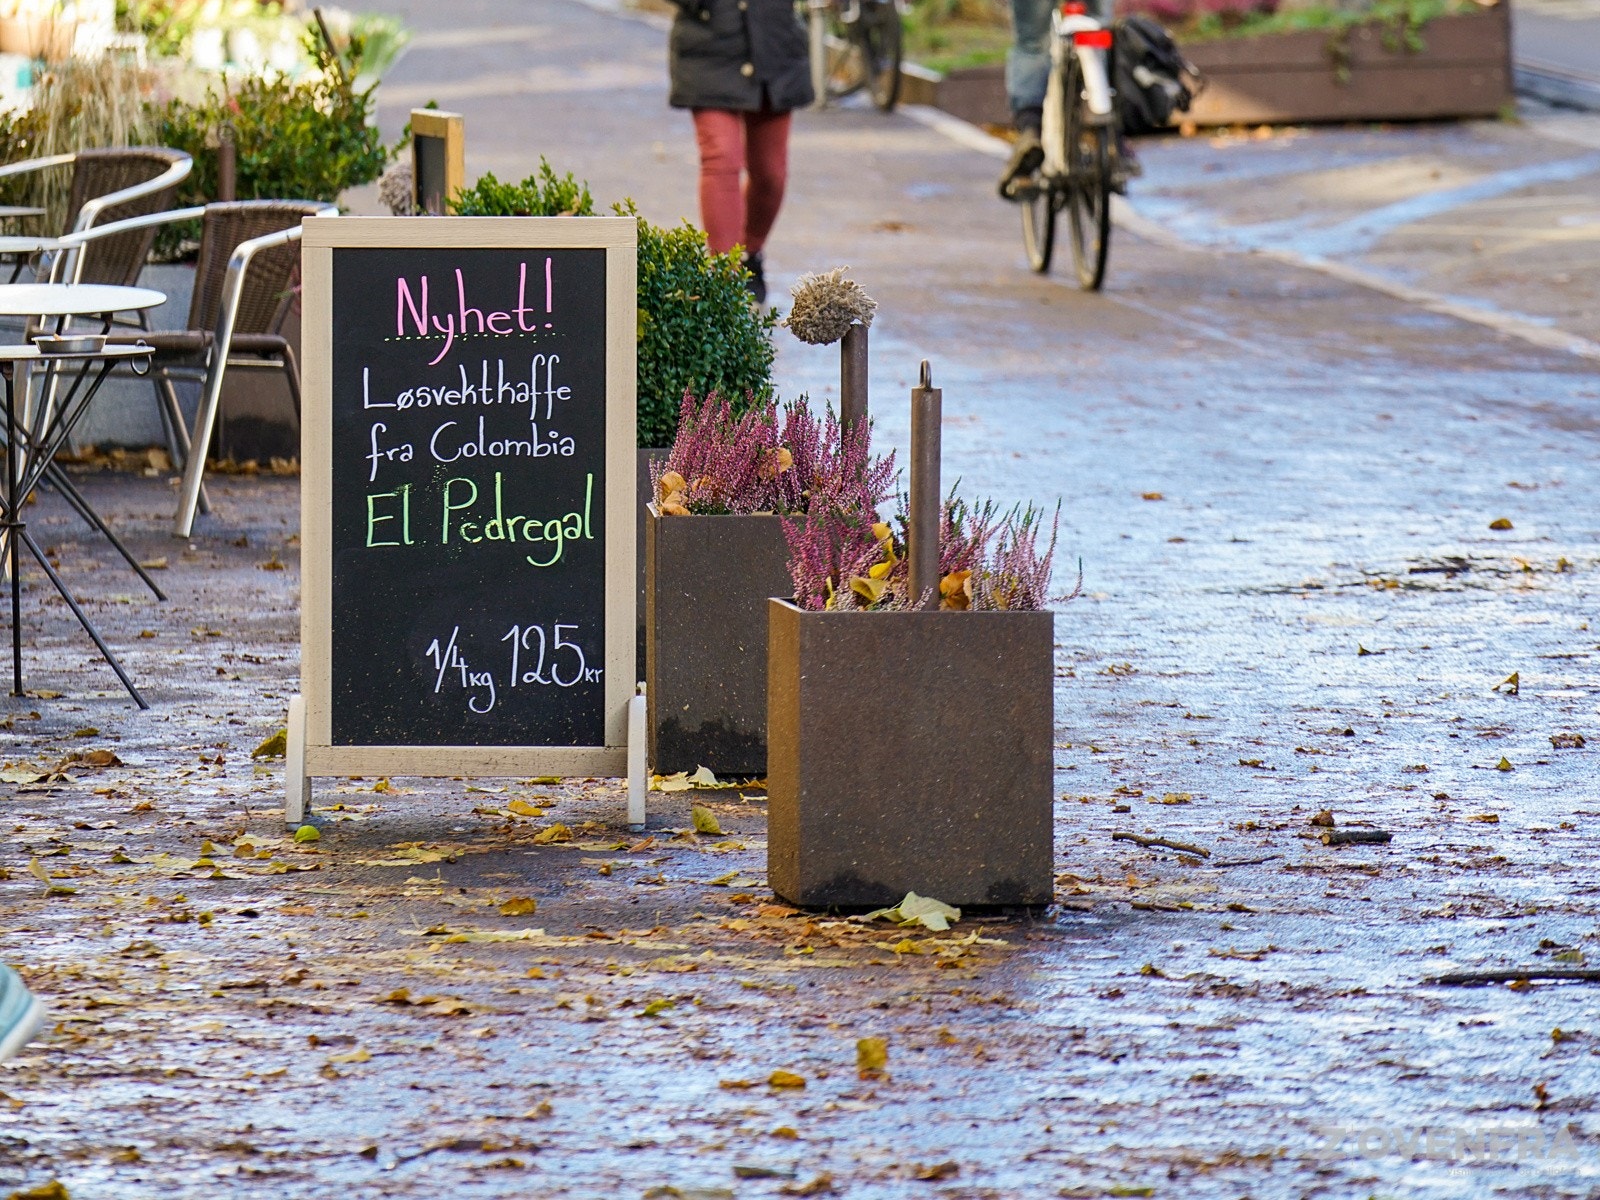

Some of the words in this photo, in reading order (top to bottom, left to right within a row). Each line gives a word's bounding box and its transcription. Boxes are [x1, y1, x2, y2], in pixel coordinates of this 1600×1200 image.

[396, 257, 553, 365] Nyhet!
[363, 354, 572, 420] Løsvektkaffe
[366, 422, 413, 482] fra
[430, 416, 576, 462] Colombia
[366, 484, 414, 547] El
[442, 471, 594, 567] Pedregal
